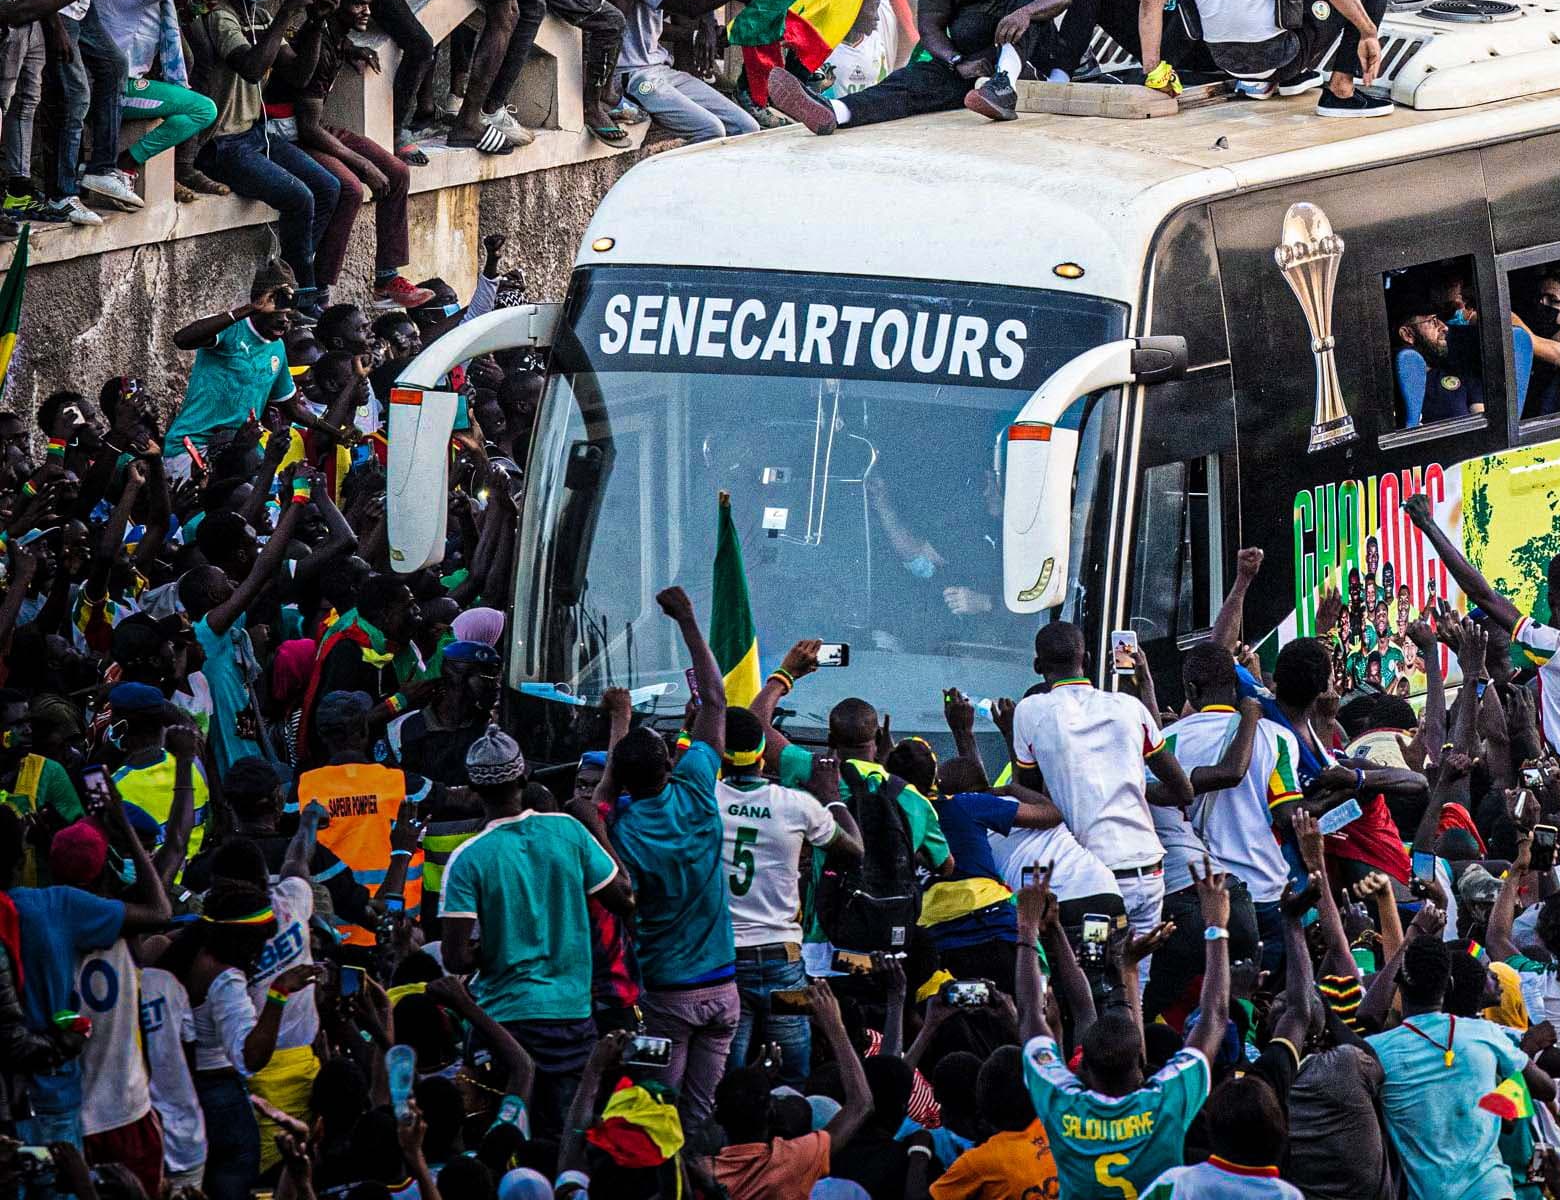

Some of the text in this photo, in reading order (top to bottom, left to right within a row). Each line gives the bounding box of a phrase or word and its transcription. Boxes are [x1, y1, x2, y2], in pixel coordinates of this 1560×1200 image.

[599, 293, 1029, 381] SENECARTOURS
[728, 804, 771, 819] GANA
[728, 826, 758, 897] 5
